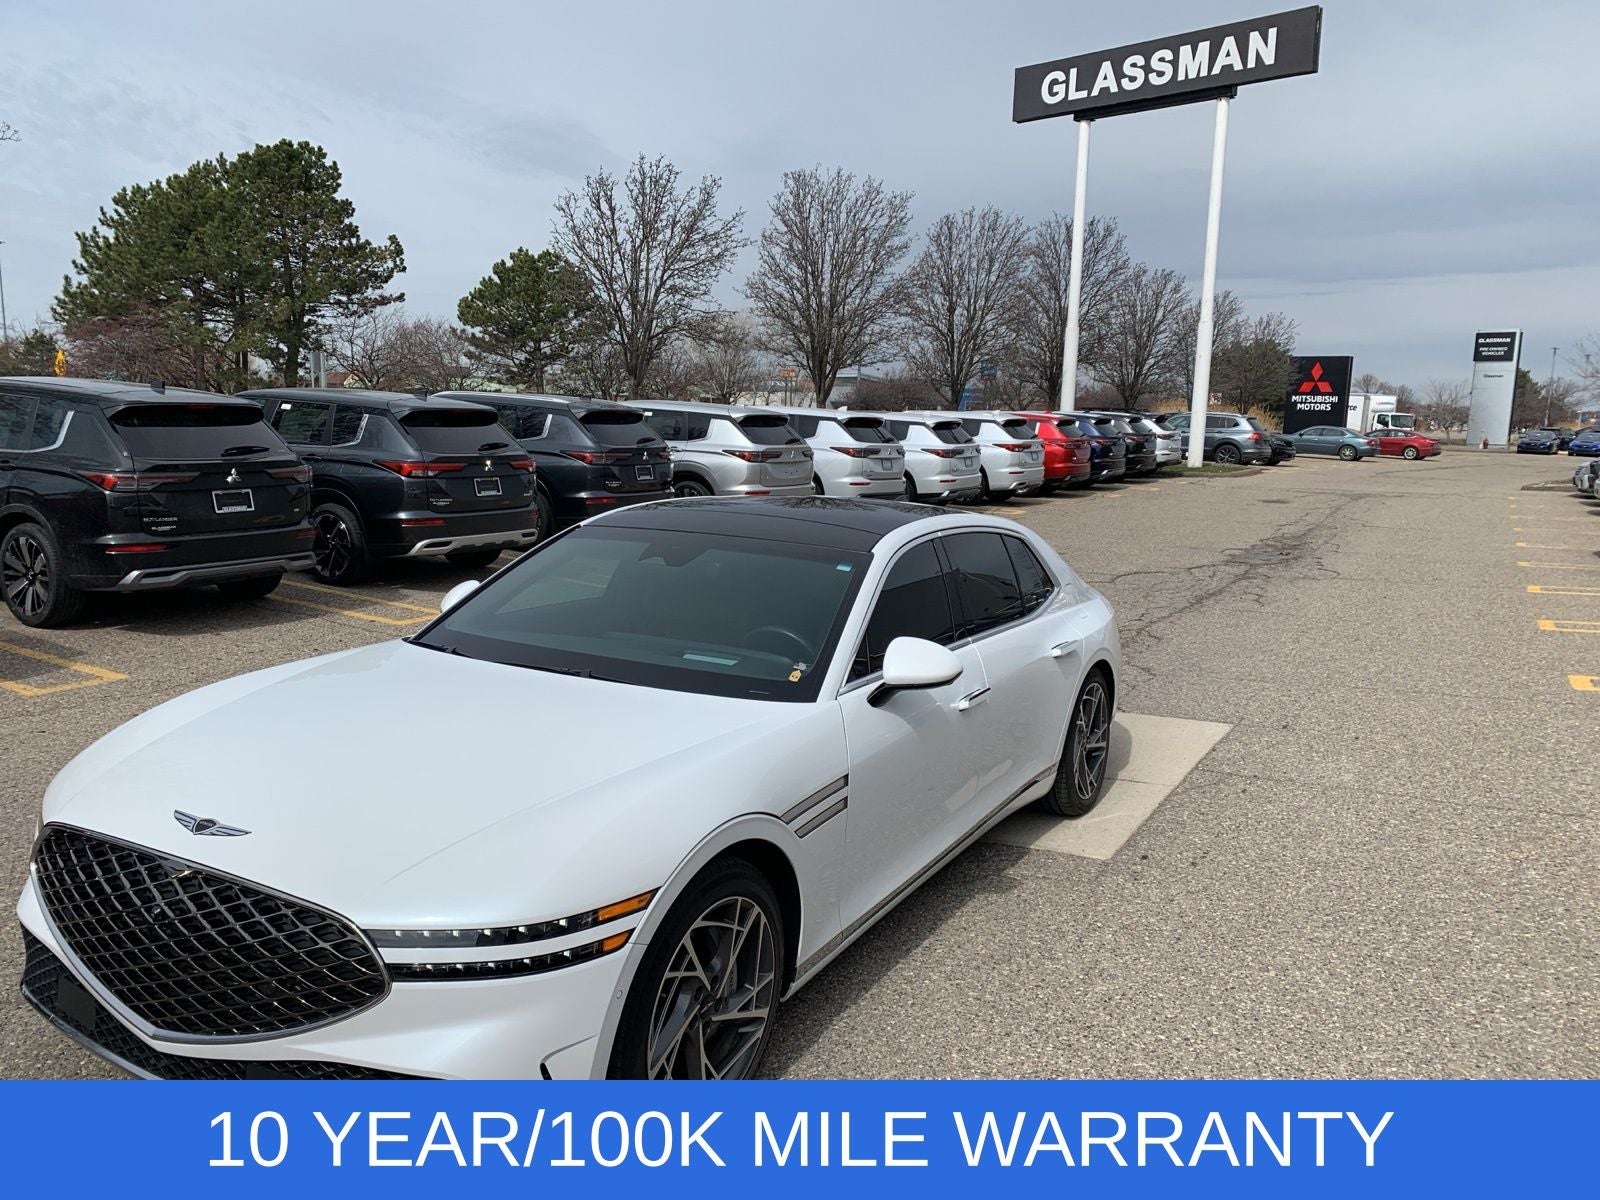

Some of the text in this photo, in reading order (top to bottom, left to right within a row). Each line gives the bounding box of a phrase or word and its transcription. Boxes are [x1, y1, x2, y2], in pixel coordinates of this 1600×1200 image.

[1041, 26, 1278, 105] GLASSMAN
[1291, 395, 1338, 403] MITSUBISHI
[1296, 403, 1332, 411] MOTORS
